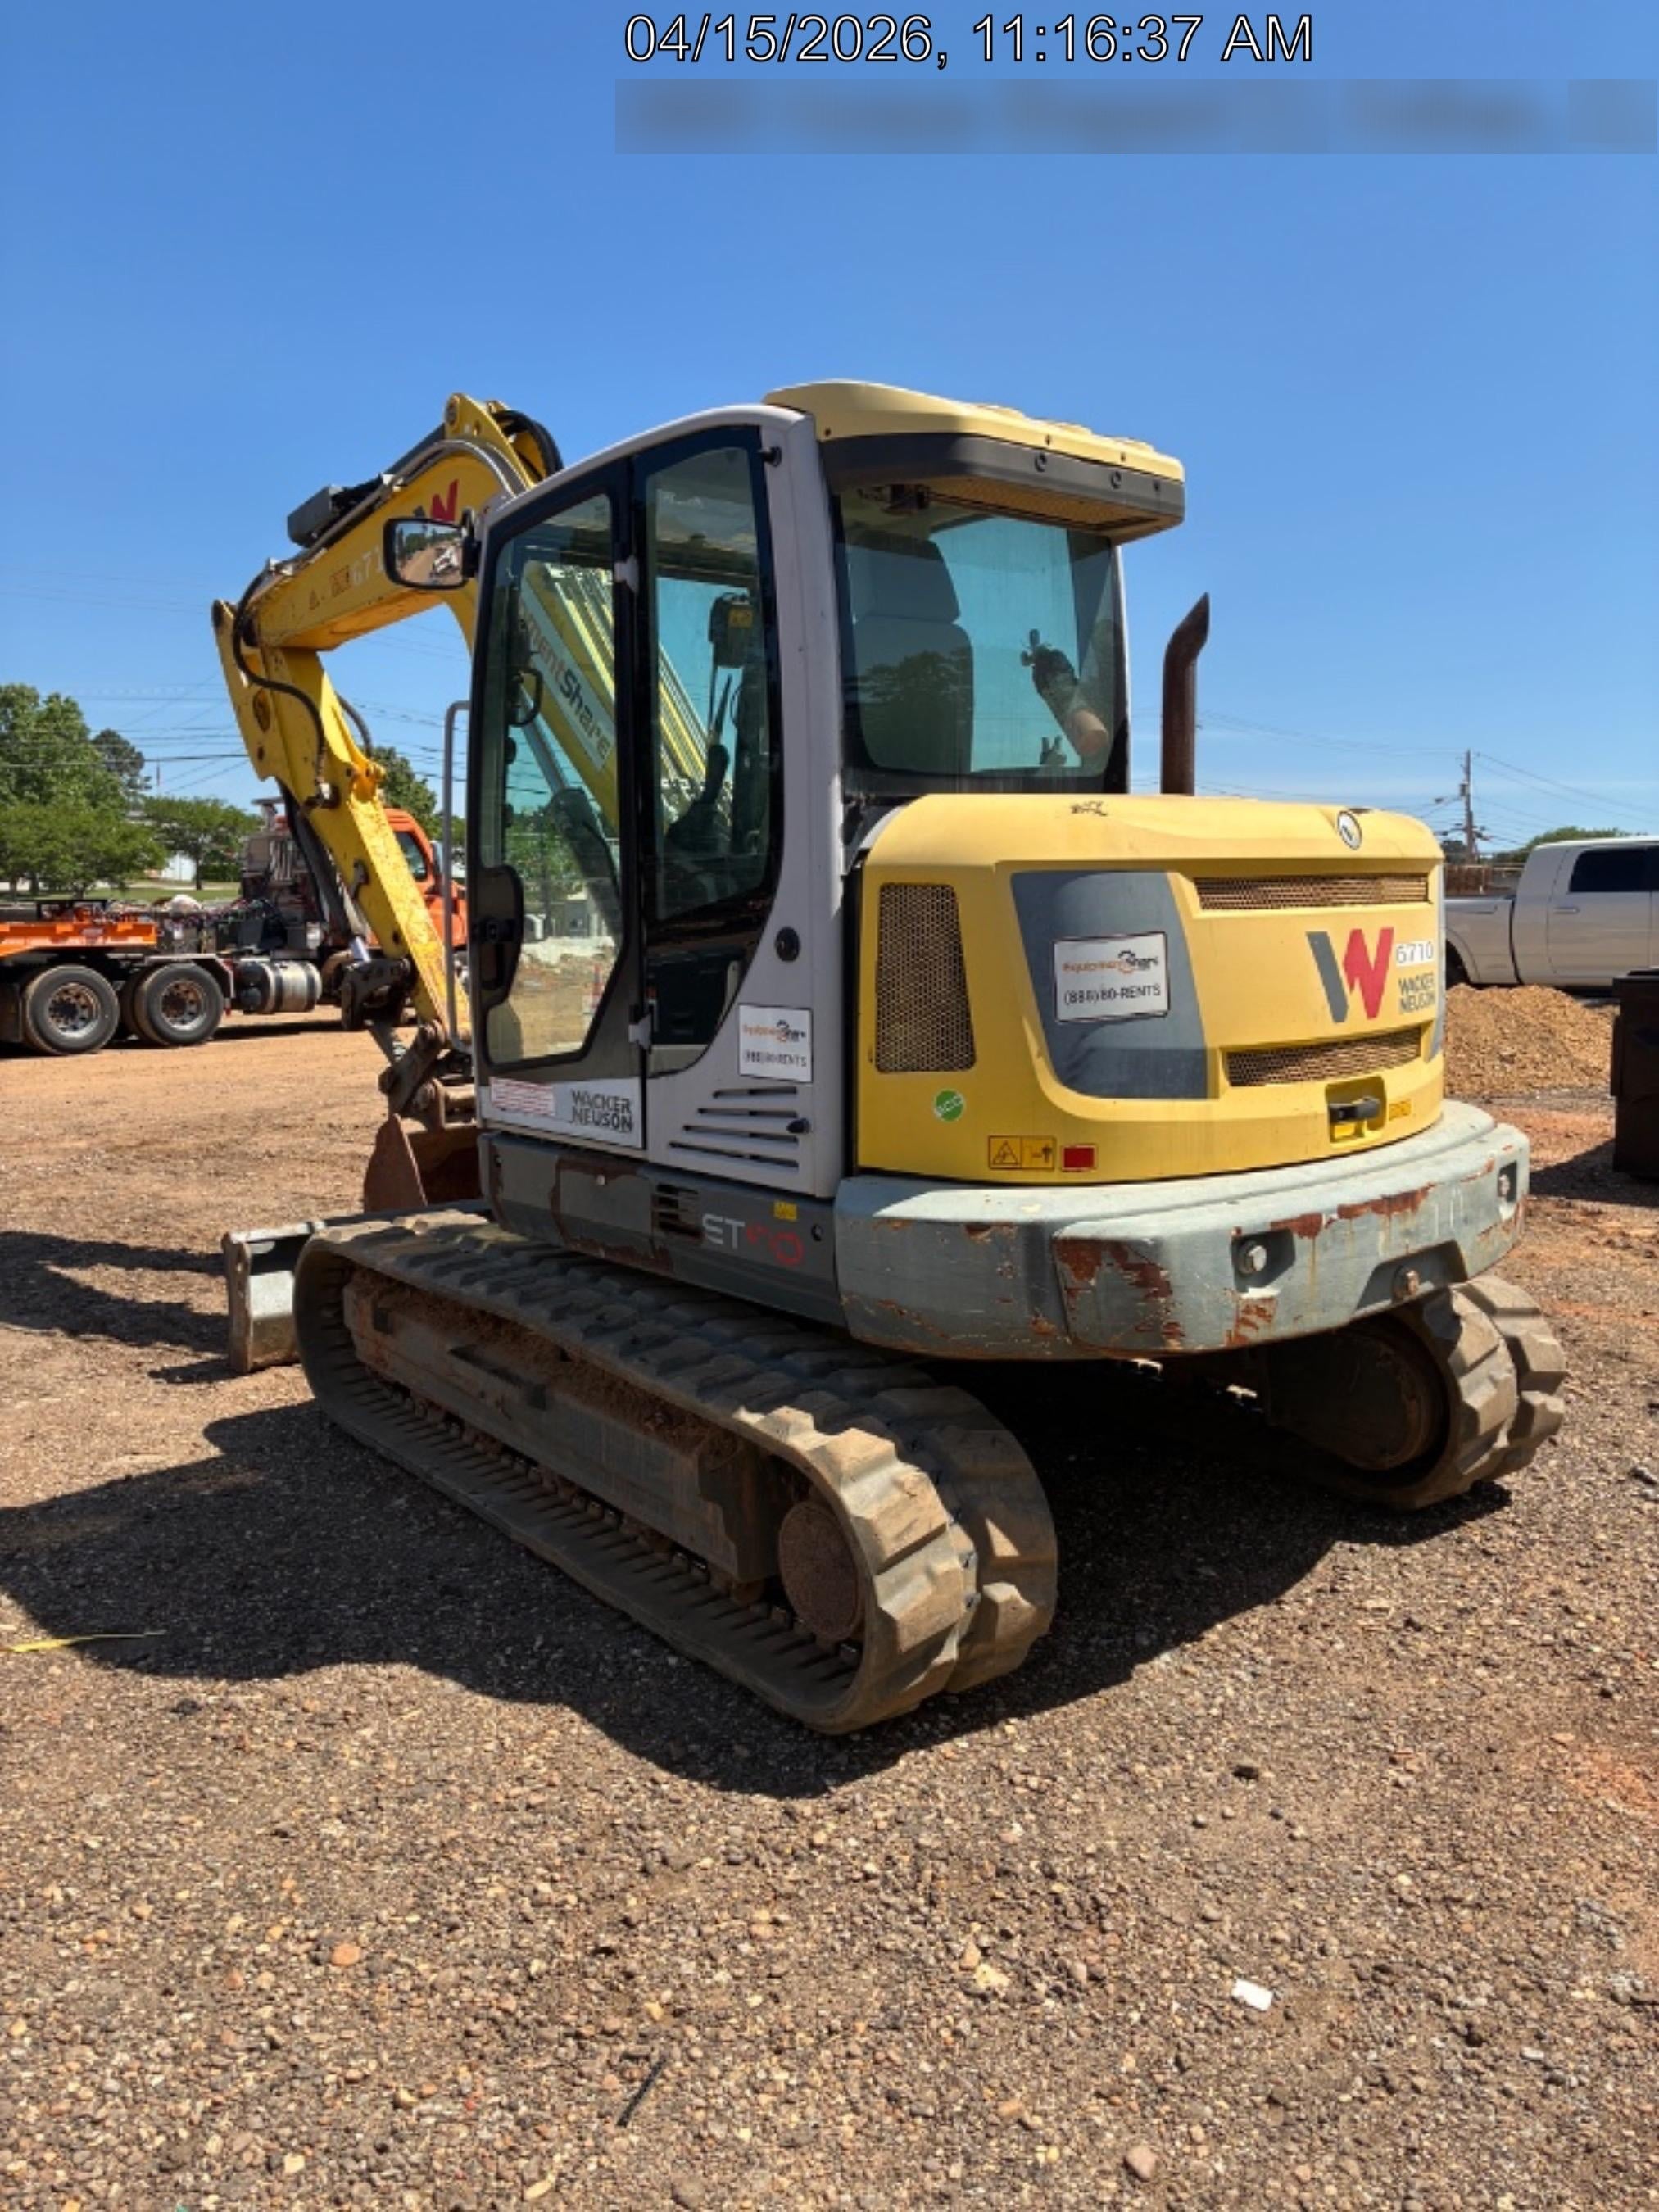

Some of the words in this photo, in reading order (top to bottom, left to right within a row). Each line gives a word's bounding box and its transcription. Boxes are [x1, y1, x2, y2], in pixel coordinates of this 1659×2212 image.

[1395, 941, 1434, 964] 6710
[571, 1089, 630, 1114] WACKER
[571, 1106, 632, 1133] NEUSON
